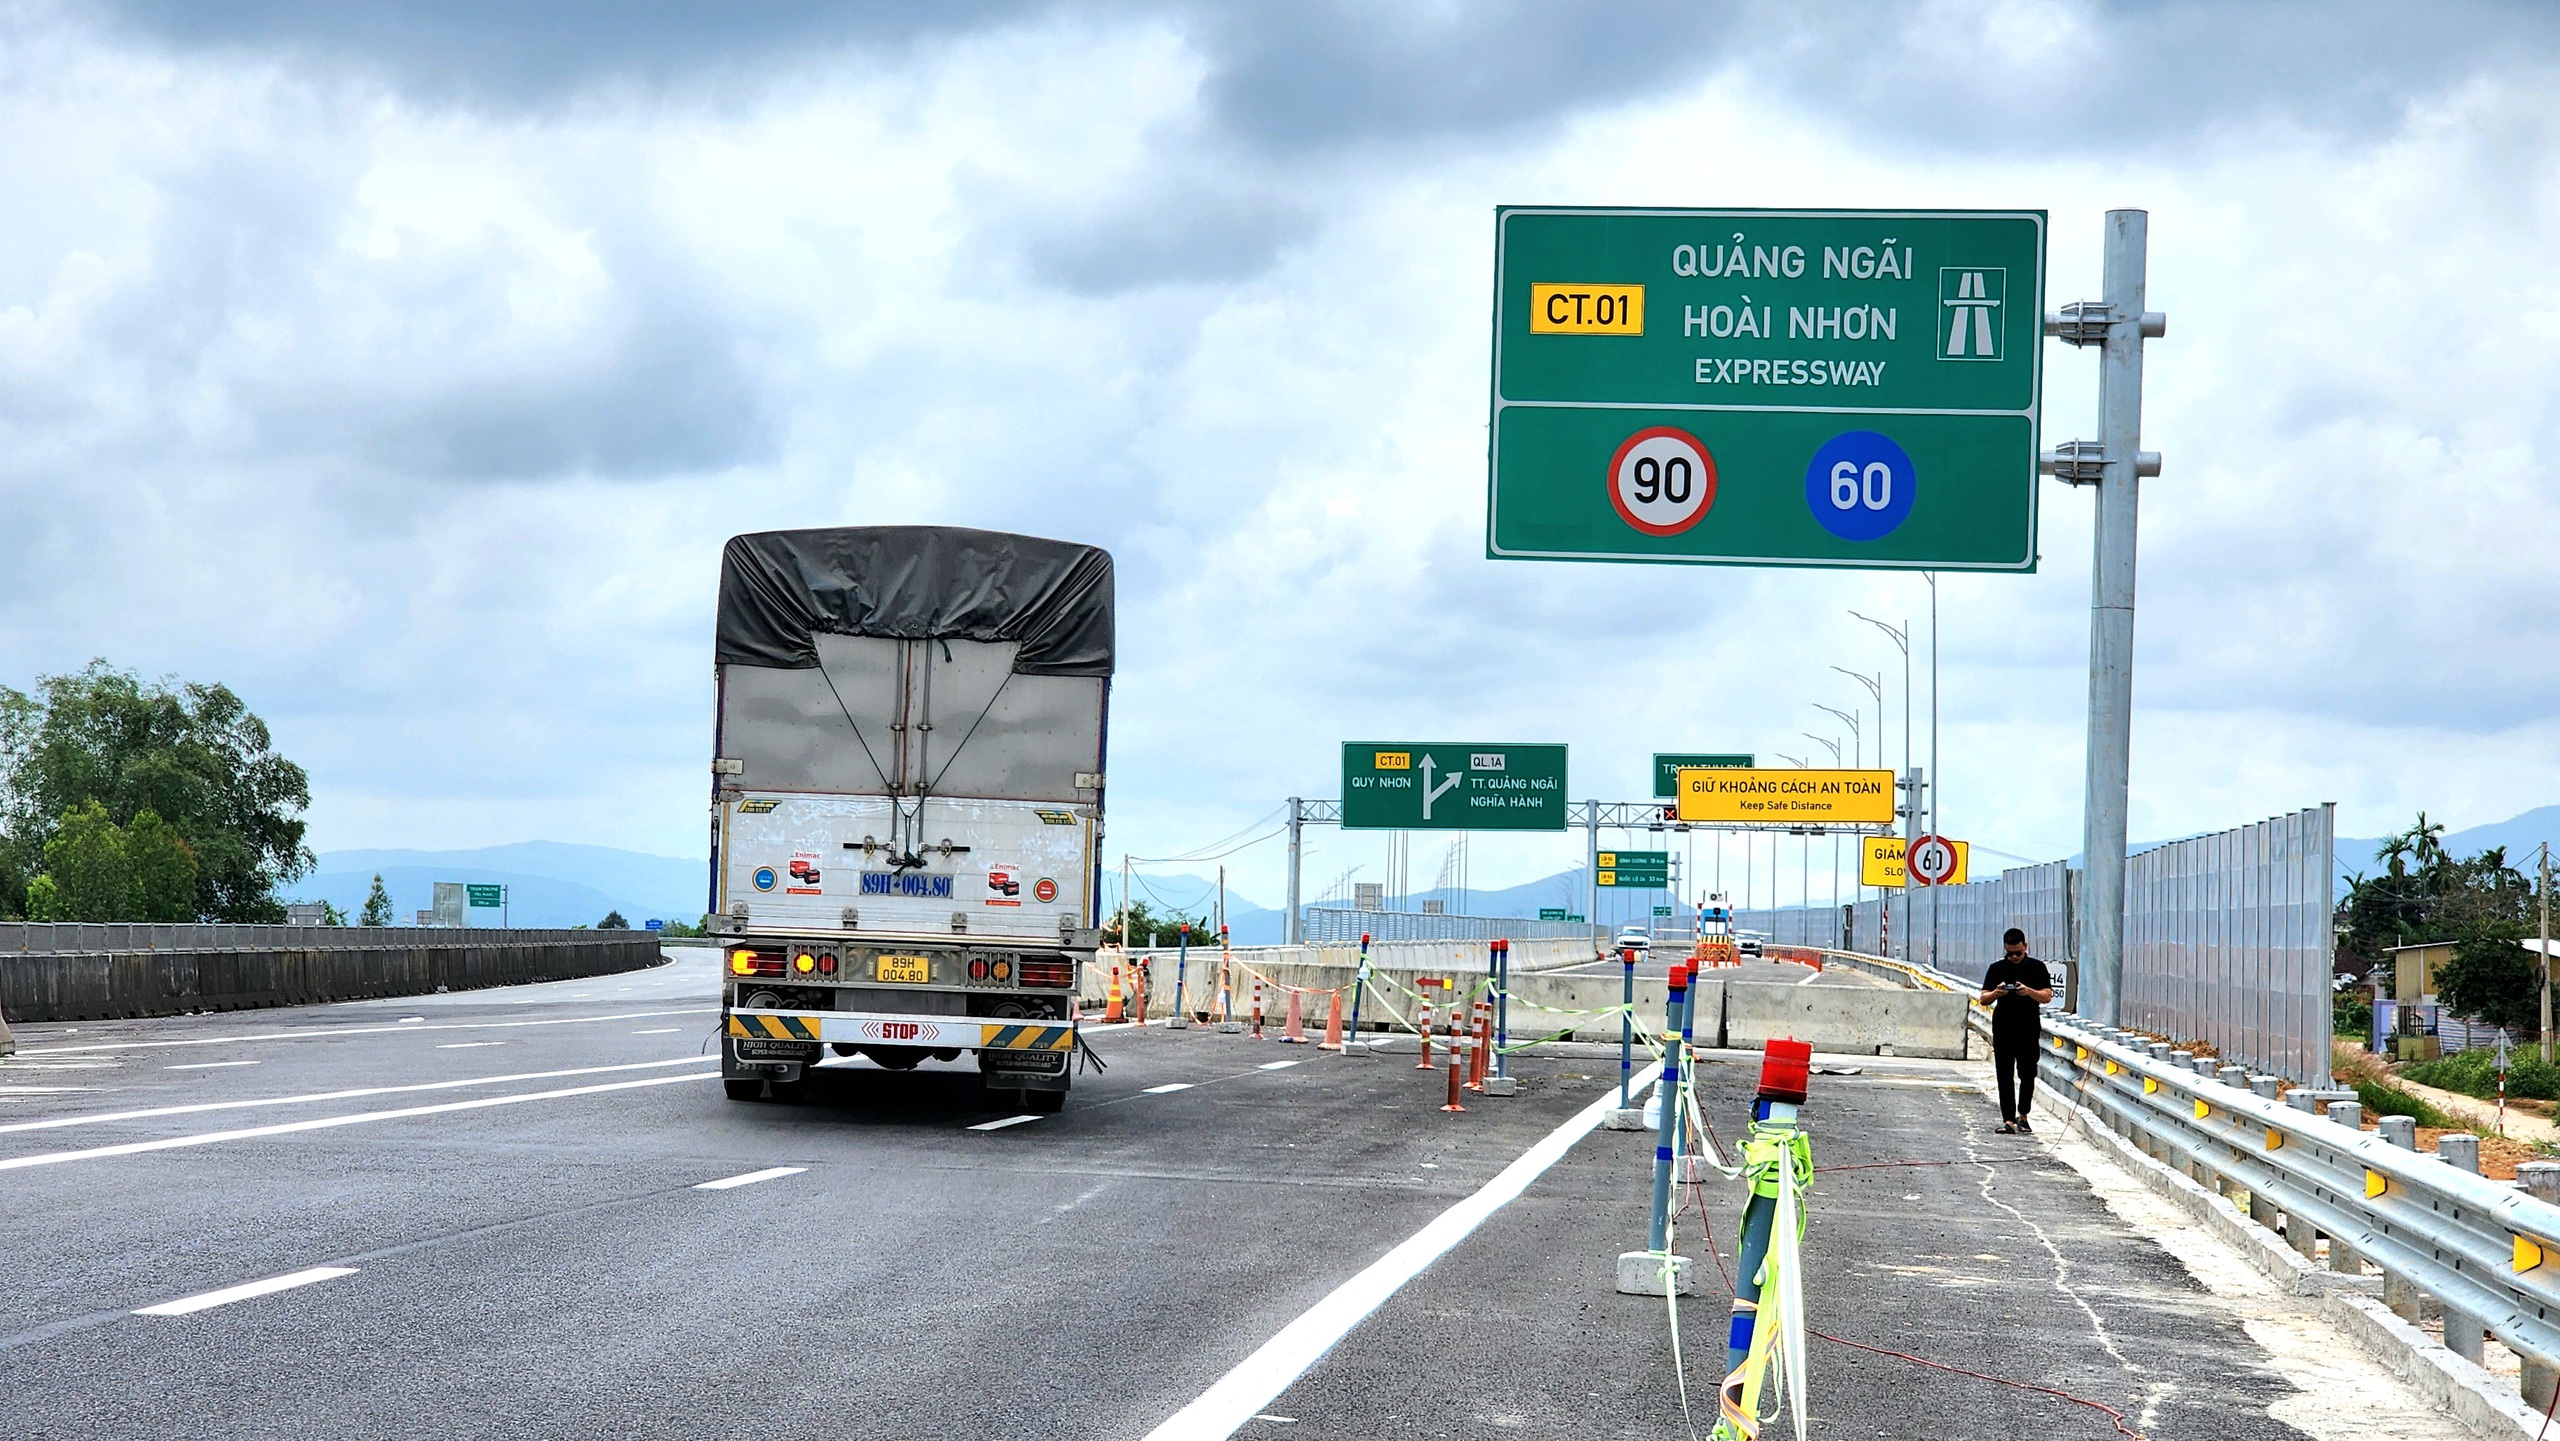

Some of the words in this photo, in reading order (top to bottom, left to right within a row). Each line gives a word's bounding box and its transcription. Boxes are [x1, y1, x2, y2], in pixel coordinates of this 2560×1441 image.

[1672, 232, 1805, 278] QUẢNG
[1823, 237, 1913, 280] NGÃI
[1546, 293, 1628, 326] CT.01
[1683, 294, 1771, 339] HOÀI
[1789, 303, 1897, 341] NHƠN
[1695, 358, 1886, 386] EXPRESSWAY
[1633, 456, 1692, 504] 90
[1830, 460, 1892, 511] 60
[1379, 755, 1406, 766] CT.01
[1472, 756, 1503, 768] QL.1A
[1352, 776, 1375, 788] QUY
[1379, 776, 1411, 788] NHƠN
[1530, 776, 1558, 790] NGÃI
[1692, 776, 1716, 794] GIỮ
[1719, 776, 1777, 794] KHOẢNG
[1780, 777, 1816, 794] CÁCH
[1820, 781, 1840, 794] AN
[1843, 777, 1881, 794] TOÀN
[1470, 793, 1506, 808] NGHĨA
[1509, 793, 1543, 808] HÀNH
[1740, 800, 1765, 811] Keep
[1767, 801, 1788, 810] Safe
[1791, 801, 1832, 811] Distance
[795, 851, 821, 859] Enimac
[1922, 849, 1943, 871] 60
[994, 863, 1020, 871] Enimac
[1884, 866, 1906, 877] SLO
[892, 957, 915, 968] 89H
[882, 969, 923, 981] 004.80
[882, 1022, 919, 1040] STOP
[769, 1042, 814, 1050] QUALITY
[1014, 1054, 1059, 1062] QUALITY
